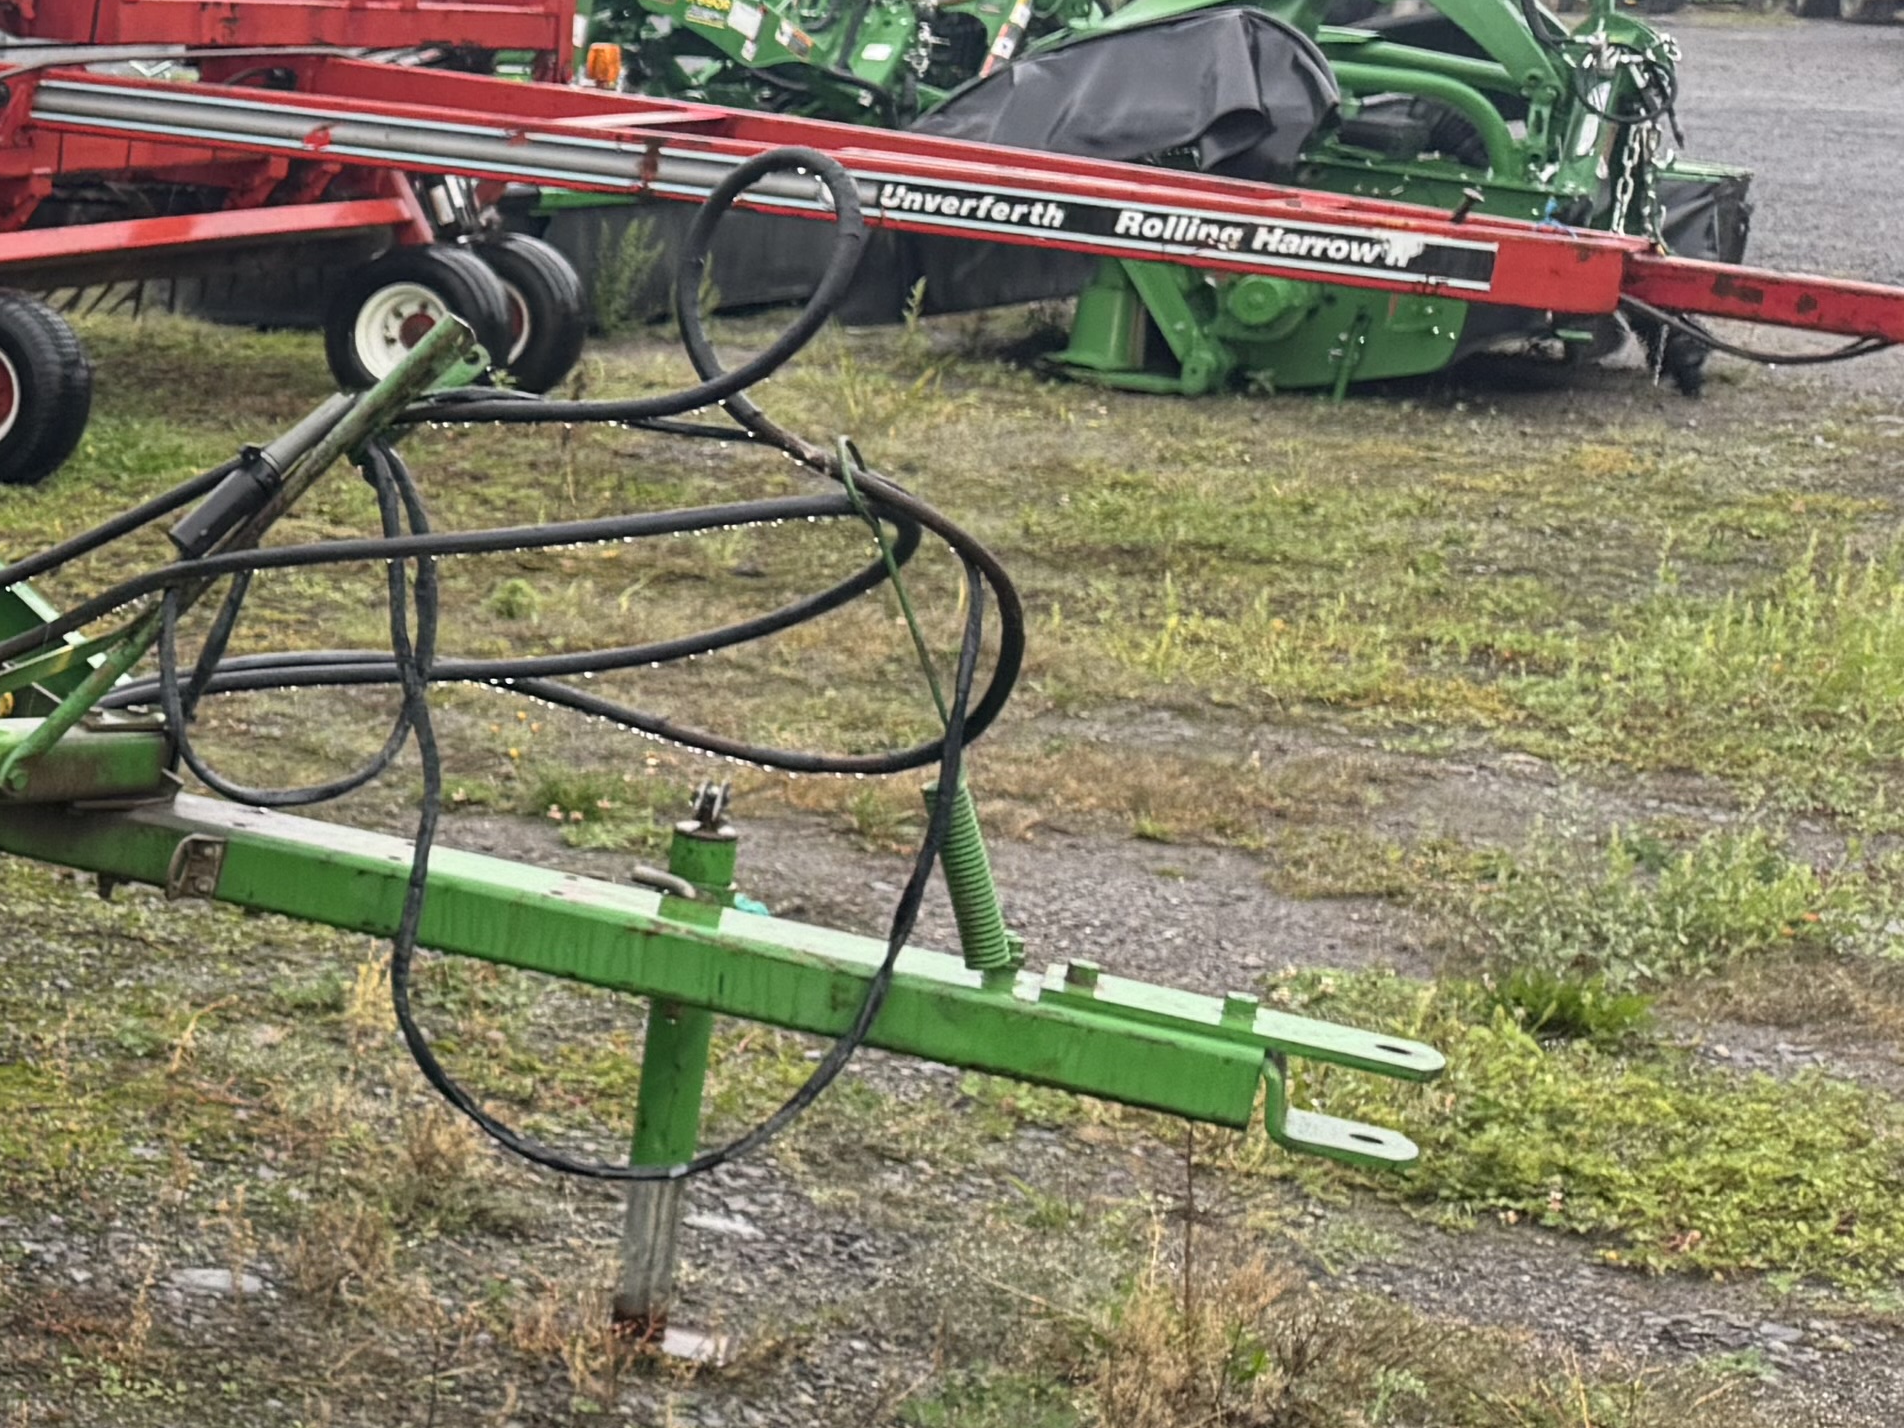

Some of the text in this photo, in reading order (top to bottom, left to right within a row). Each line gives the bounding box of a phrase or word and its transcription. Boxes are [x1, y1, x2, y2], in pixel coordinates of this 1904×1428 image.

[879, 183, 1065, 229] Unverferth
[1113, 209, 1244, 252] Rolling
[1250, 226, 1382, 265] Harrow
